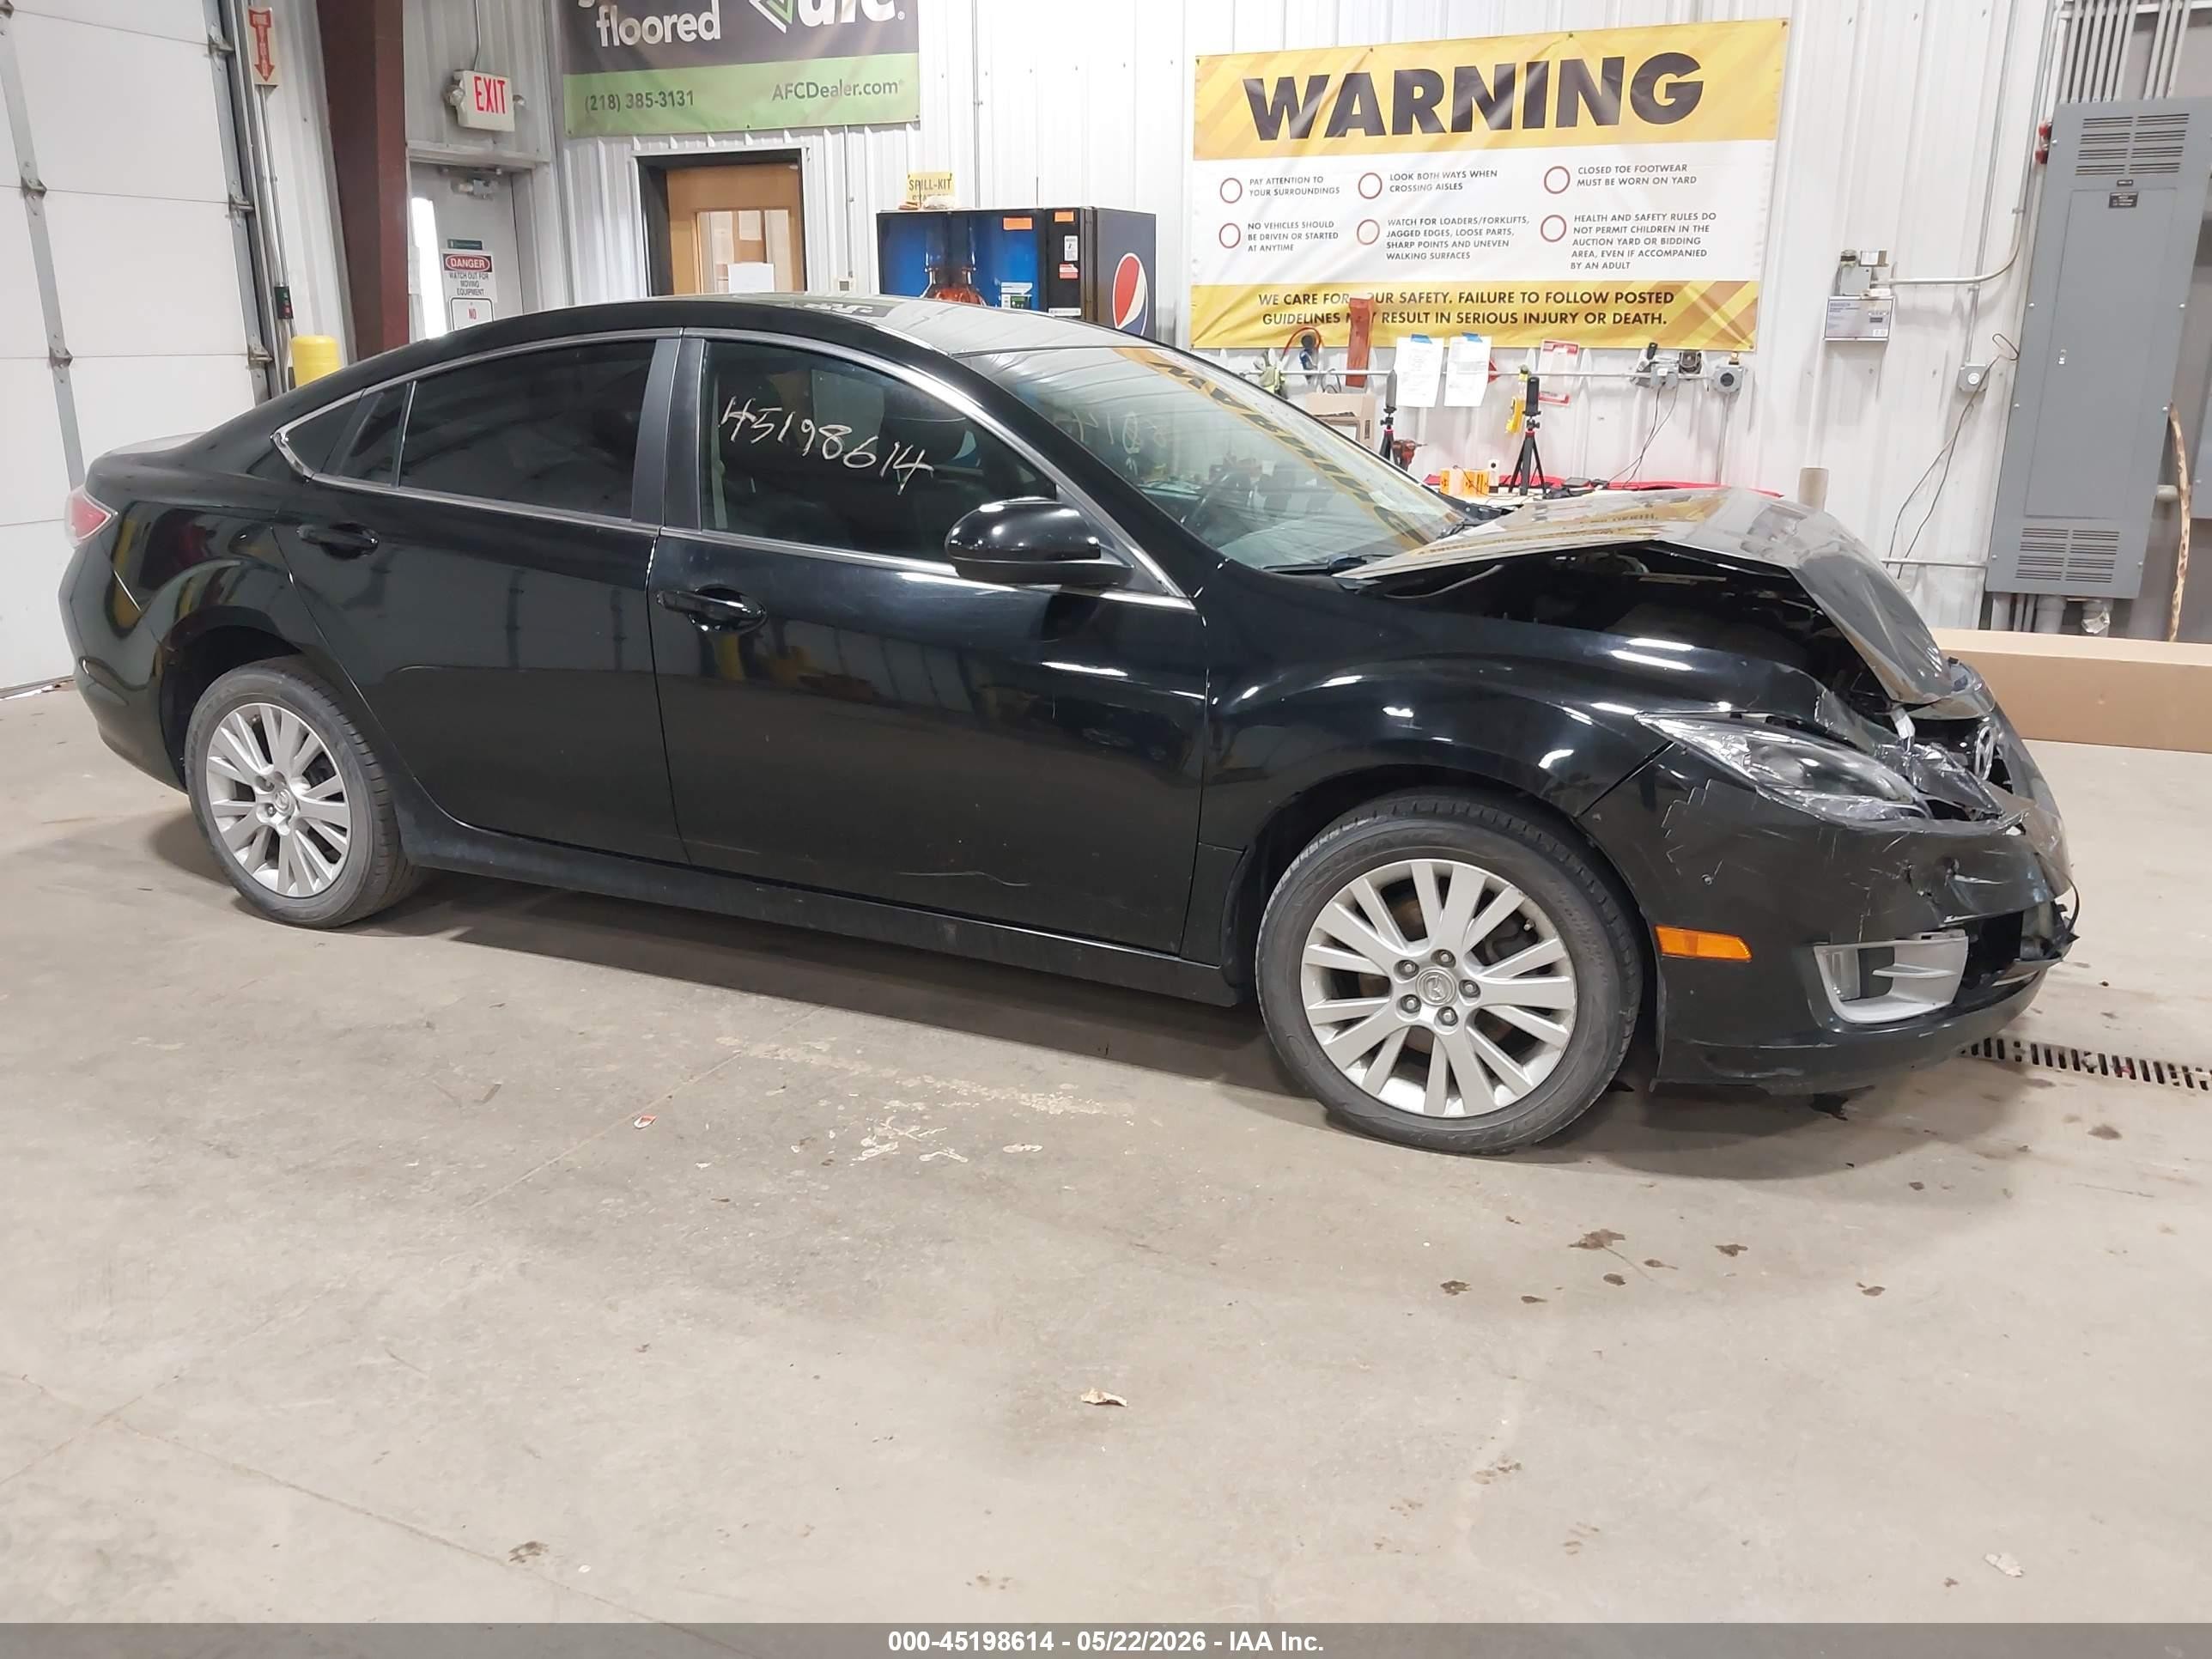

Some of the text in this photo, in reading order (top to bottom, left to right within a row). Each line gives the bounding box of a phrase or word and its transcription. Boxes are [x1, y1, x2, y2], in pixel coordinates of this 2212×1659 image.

[596, 0, 720, 47] floored
[474, 76, 506, 114] EXIT
[772, 79, 898, 101] AFCDealer.com
[585, 89, 694, 112] (218) 385-3131
[1243, 52, 1704, 141] WARNING
[1634, 164, 1687, 173] FOOTWEAR
[1443, 171, 1467, 179] WAYS
[908, 179, 951, 191] SPILL-KIT
[1266, 176, 1310, 185] ATTENTION
[1619, 177, 1650, 185] WORN
[1273, 187, 1340, 196] SURROUNDINGS
[1439, 216, 1530, 226] LOADERS/FORKLIFTS,
[1634, 213, 1668, 222] SAFETY
[1701, 212, 1717, 221] DO
[1424, 229, 1453, 238] EDGES,
[1455, 228, 1483, 237] LOOSE
[1486, 228, 1515, 237] PARTS,
[1631, 225, 1675, 234] CHILDREN
[1692, 224, 1711, 233] THE
[1418, 240, 1449, 249] POINTS
[1572, 238, 1613, 246] AUCTION
[1571, 250, 1598, 258] AREA,
[1638, 249, 1707, 258] ACCOMPANIED
[450, 258, 485, 269] DANGER
[1601, 261, 1631, 270] ADULT
[1259, 294, 1279, 306] WE
[1283, 293, 1318, 305] CARE
[1322, 293, 1350, 305] FOR
[1399, 292, 1453, 304] SAFETY.
[1458, 291, 1515, 304] FAILURE
[1520, 291, 1540, 304] TO
[1545, 291, 1610, 304] FOLLOW
[1614, 291, 1674, 304] POSTED
[468, 308, 477, 319] NO
[1262, 313, 1340, 325] GUIDELINES
[1382, 312, 1431, 324] RESULT
[1435, 312, 1450, 324] IN
[1455, 312, 1518, 325] SERIOUS
[1523, 312, 1579, 325] INJURY
[1584, 312, 1607, 325] OR
[1613, 312, 1668, 325] DEATH.
